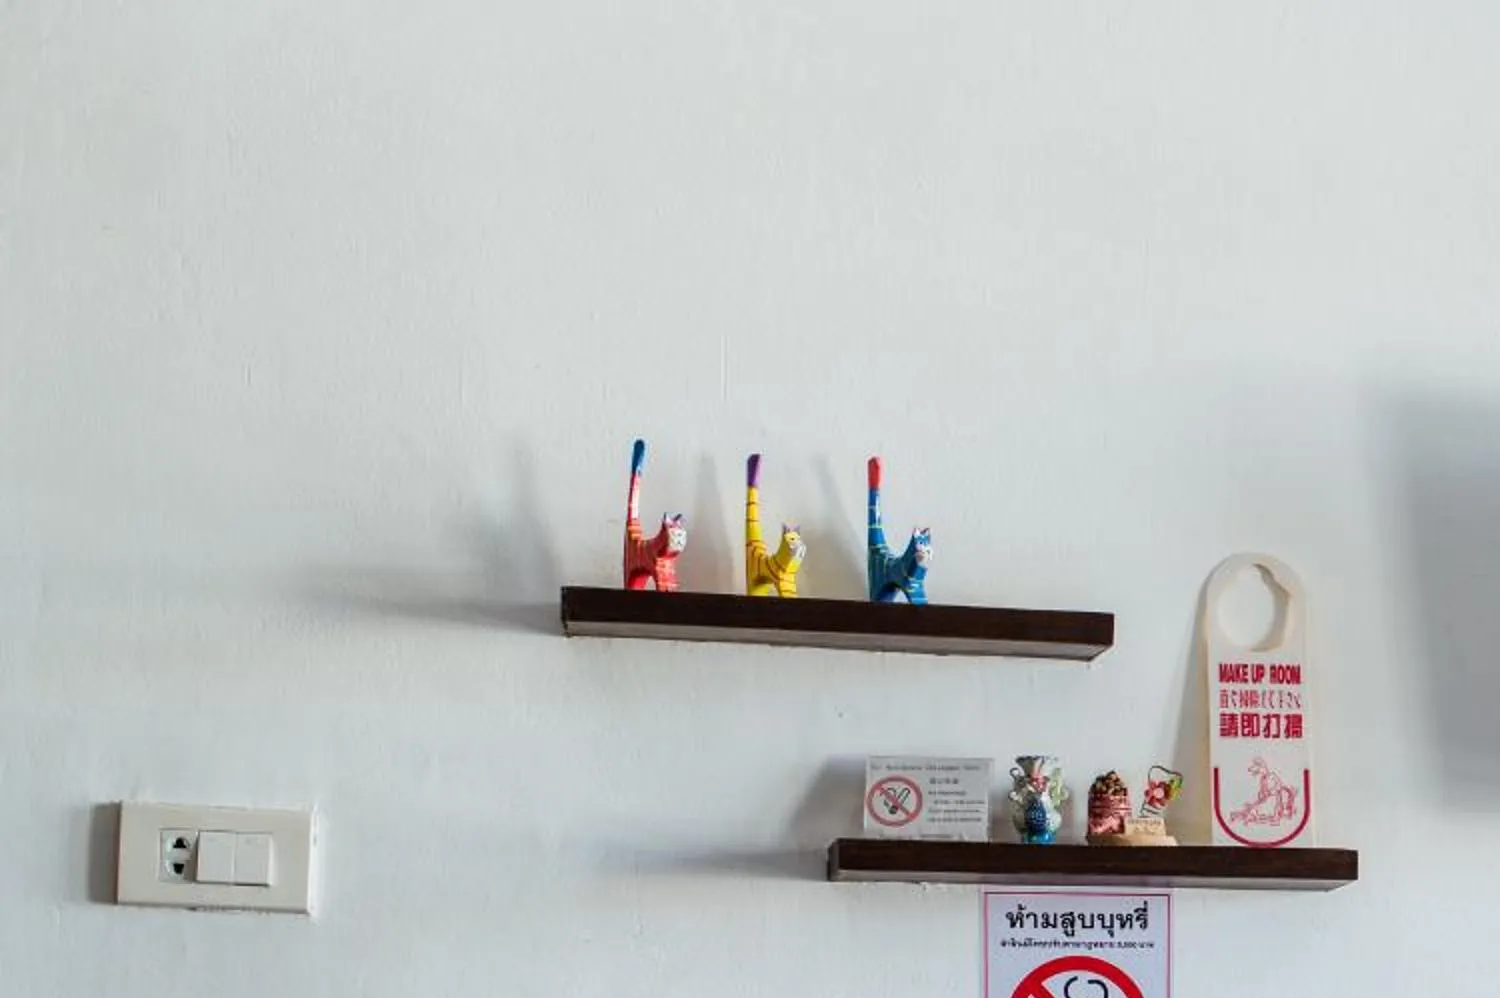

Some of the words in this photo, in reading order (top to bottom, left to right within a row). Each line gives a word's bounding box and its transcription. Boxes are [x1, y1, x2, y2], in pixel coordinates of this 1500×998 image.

[1218, 663, 1249, 683] MAKE
[1251, 664, 1264, 684] UP
[1269, 665, 1302, 685] ROOM
[1005, 900, 1149, 938] ห้ามสูบบุหรี่
